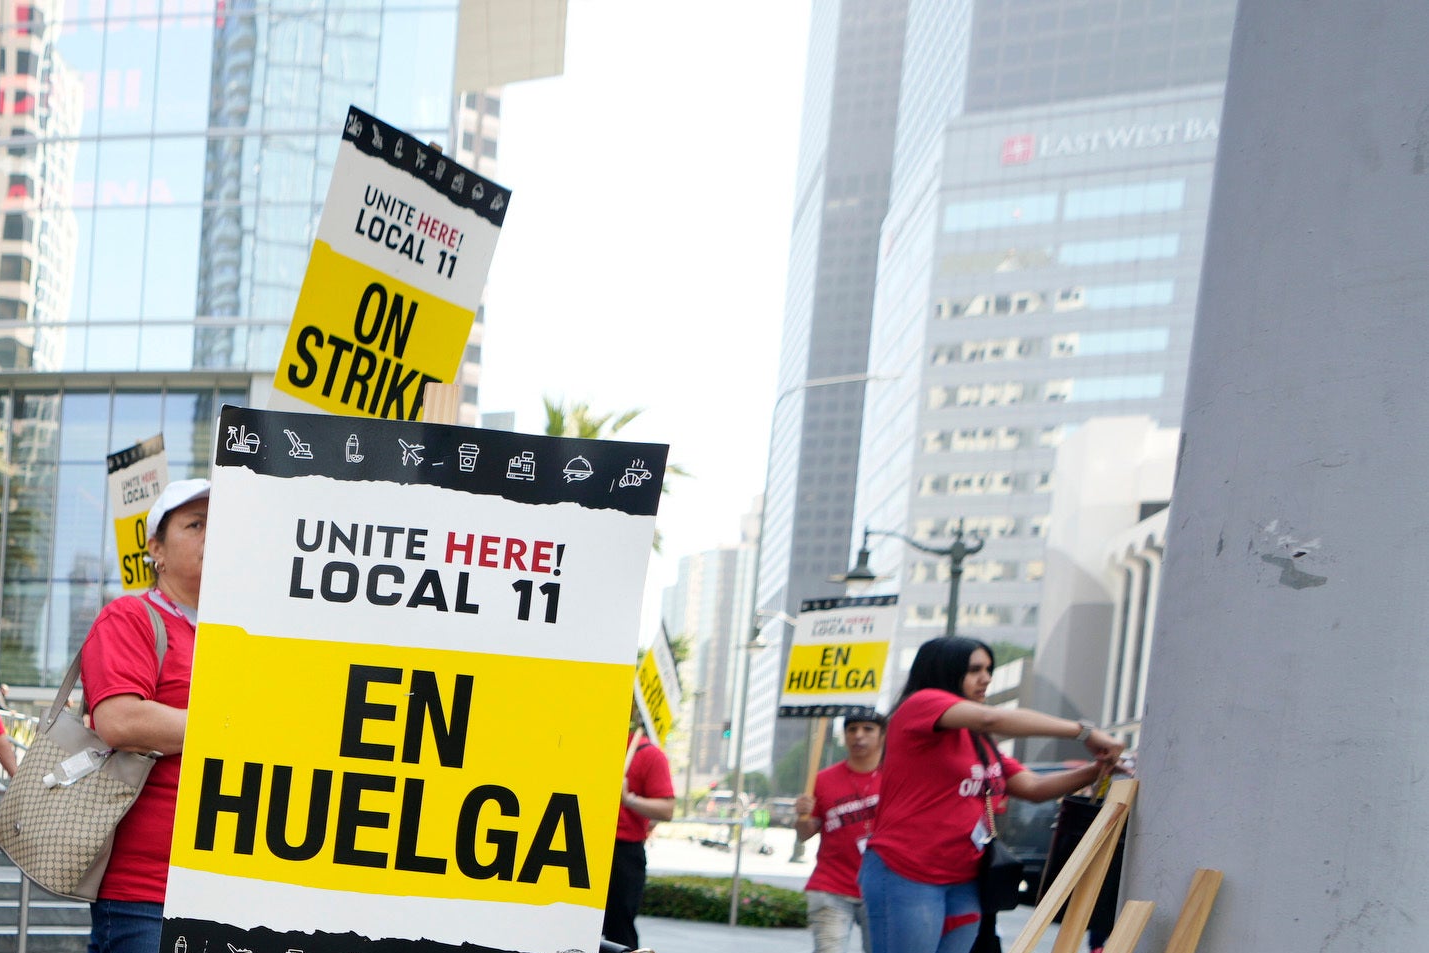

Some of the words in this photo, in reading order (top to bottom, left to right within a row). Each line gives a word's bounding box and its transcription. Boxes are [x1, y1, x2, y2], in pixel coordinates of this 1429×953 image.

[354, 208, 425, 265] LOCAL
[437, 250, 458, 279] 11
[364, 184, 417, 228] UNITE
[416, 212, 464, 252] HERE!
[353, 282, 419, 360] ON
[123, 487, 149, 505] LOCAL
[135, 516, 147, 550] O
[295, 518, 429, 561] UNITE
[444, 531, 566, 577] HERE!
[123, 553, 154, 585] STR
[289, 556, 480, 615] LOCAL
[511, 579, 562, 625] 11
[811, 625, 854, 637] LOCAL
[820, 646, 851, 667] EN
[787, 669, 876, 690] HUELGA
[339, 663, 475, 769] EN
[193, 757, 591, 890] HUELGA
